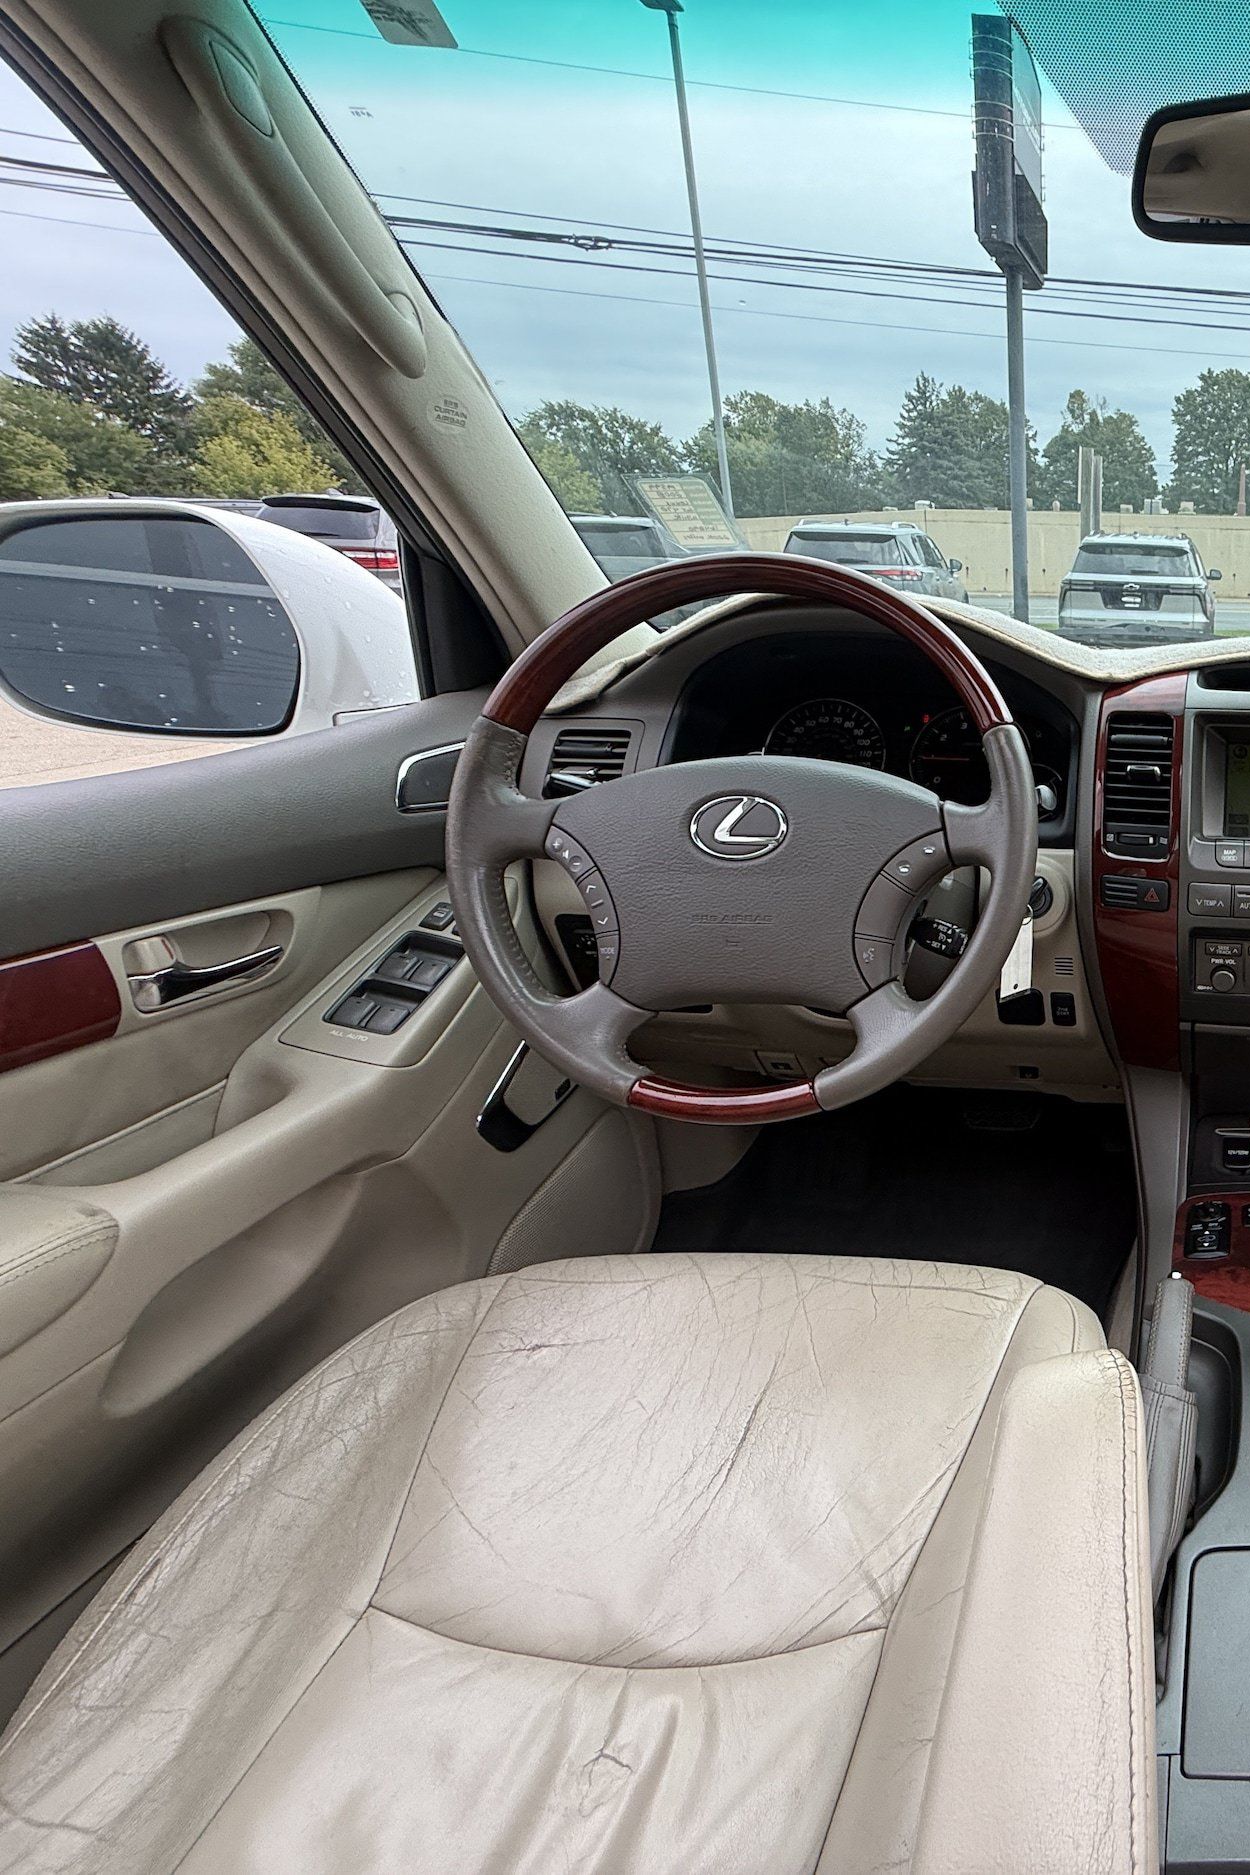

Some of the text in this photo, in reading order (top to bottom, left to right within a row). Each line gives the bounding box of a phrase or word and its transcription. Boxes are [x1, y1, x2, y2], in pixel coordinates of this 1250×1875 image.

[434, 405, 468, 420] CURTAIN
[435, 414, 466, 427] AIRBAG
[721, 914, 774, 923] AIRBAG
[330, 1029, 369, 1041] ALL AUTO
